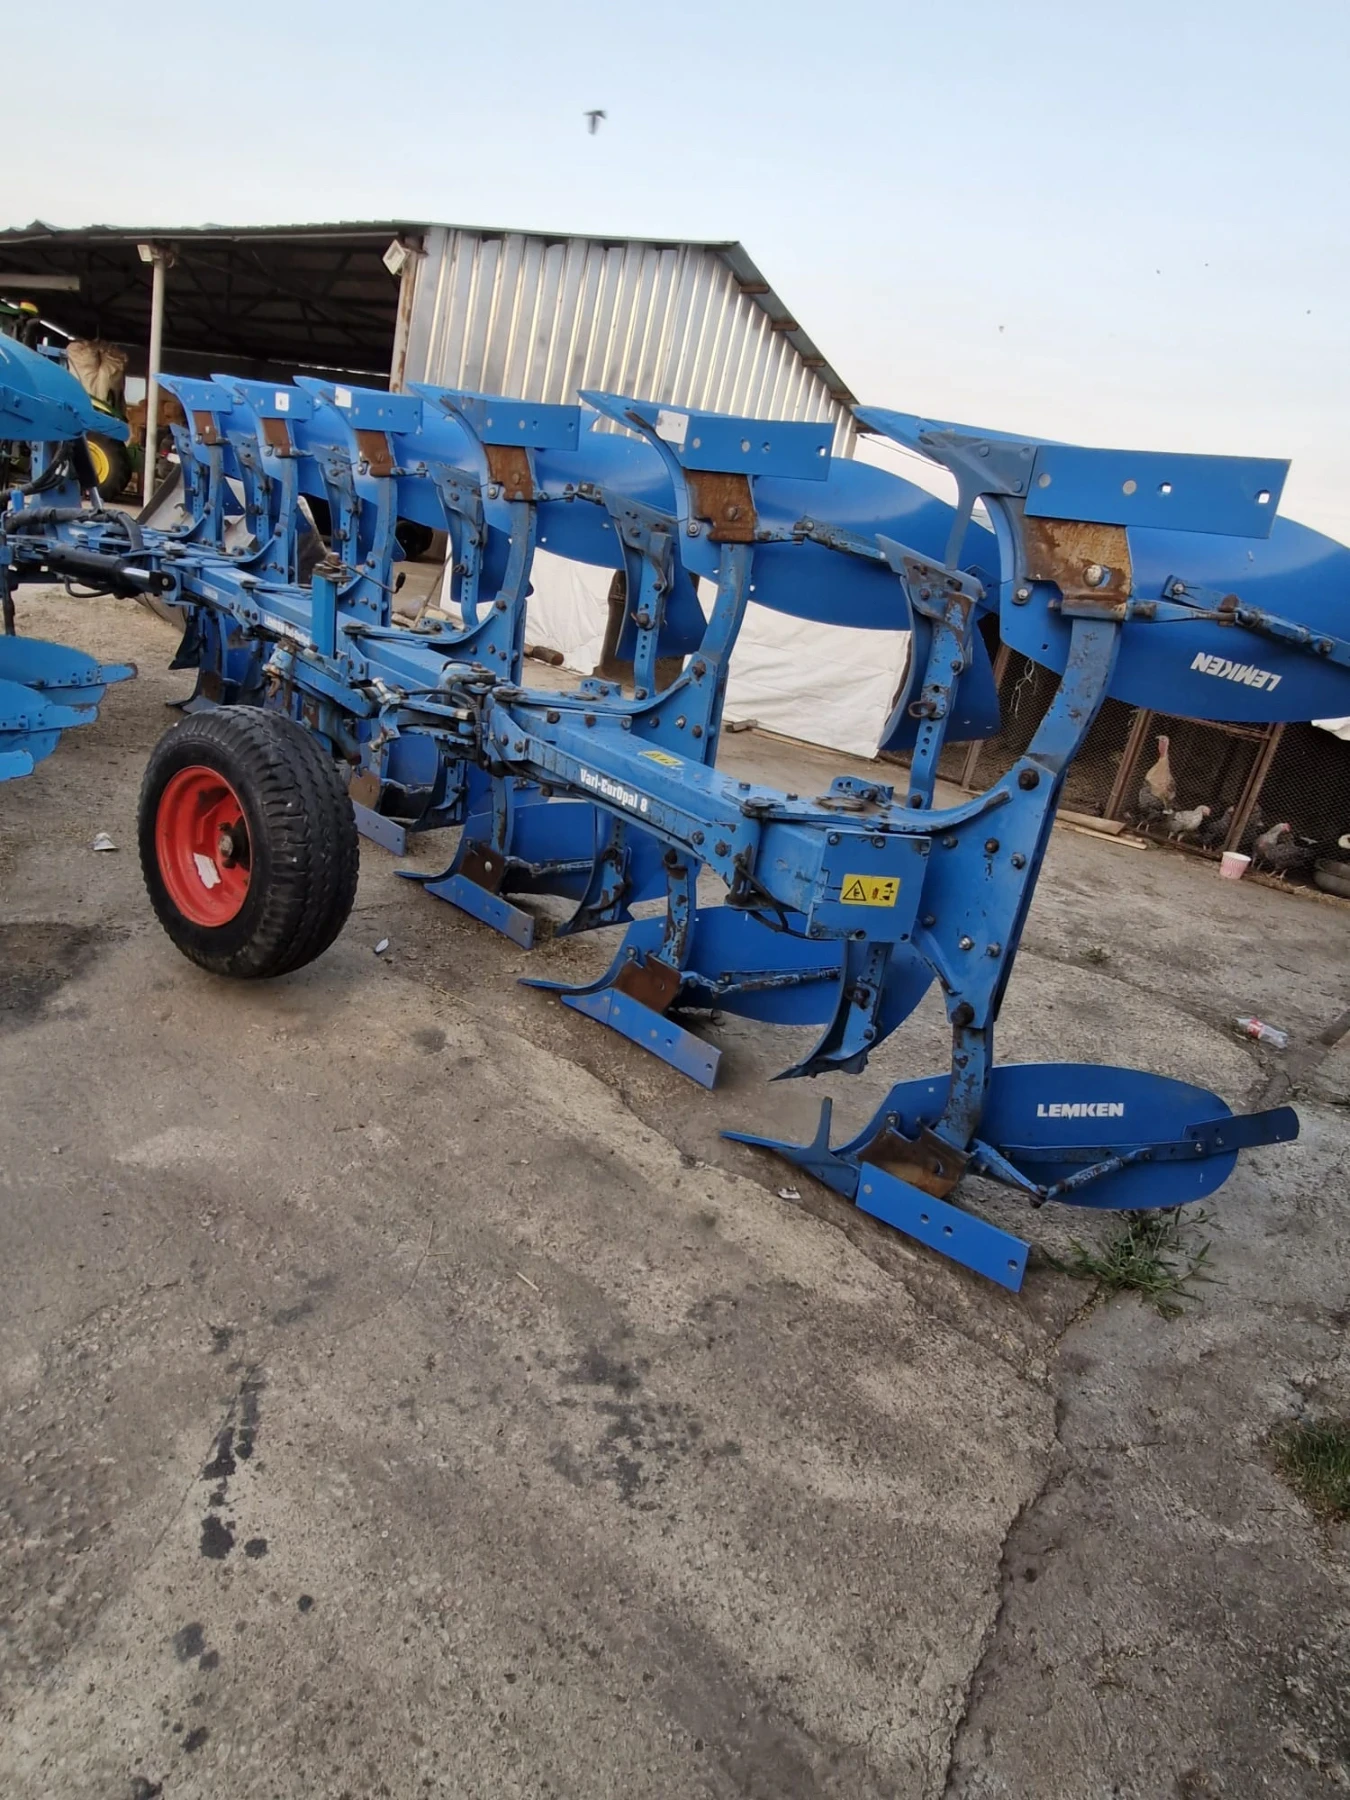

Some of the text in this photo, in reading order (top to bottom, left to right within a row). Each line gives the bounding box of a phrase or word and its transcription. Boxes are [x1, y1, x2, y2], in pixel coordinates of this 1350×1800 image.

[1190, 652, 1282, 692] LEMKEN
[640, 797, 648, 812] 8
[1036, 1102, 1124, 1120] LEMKEN
